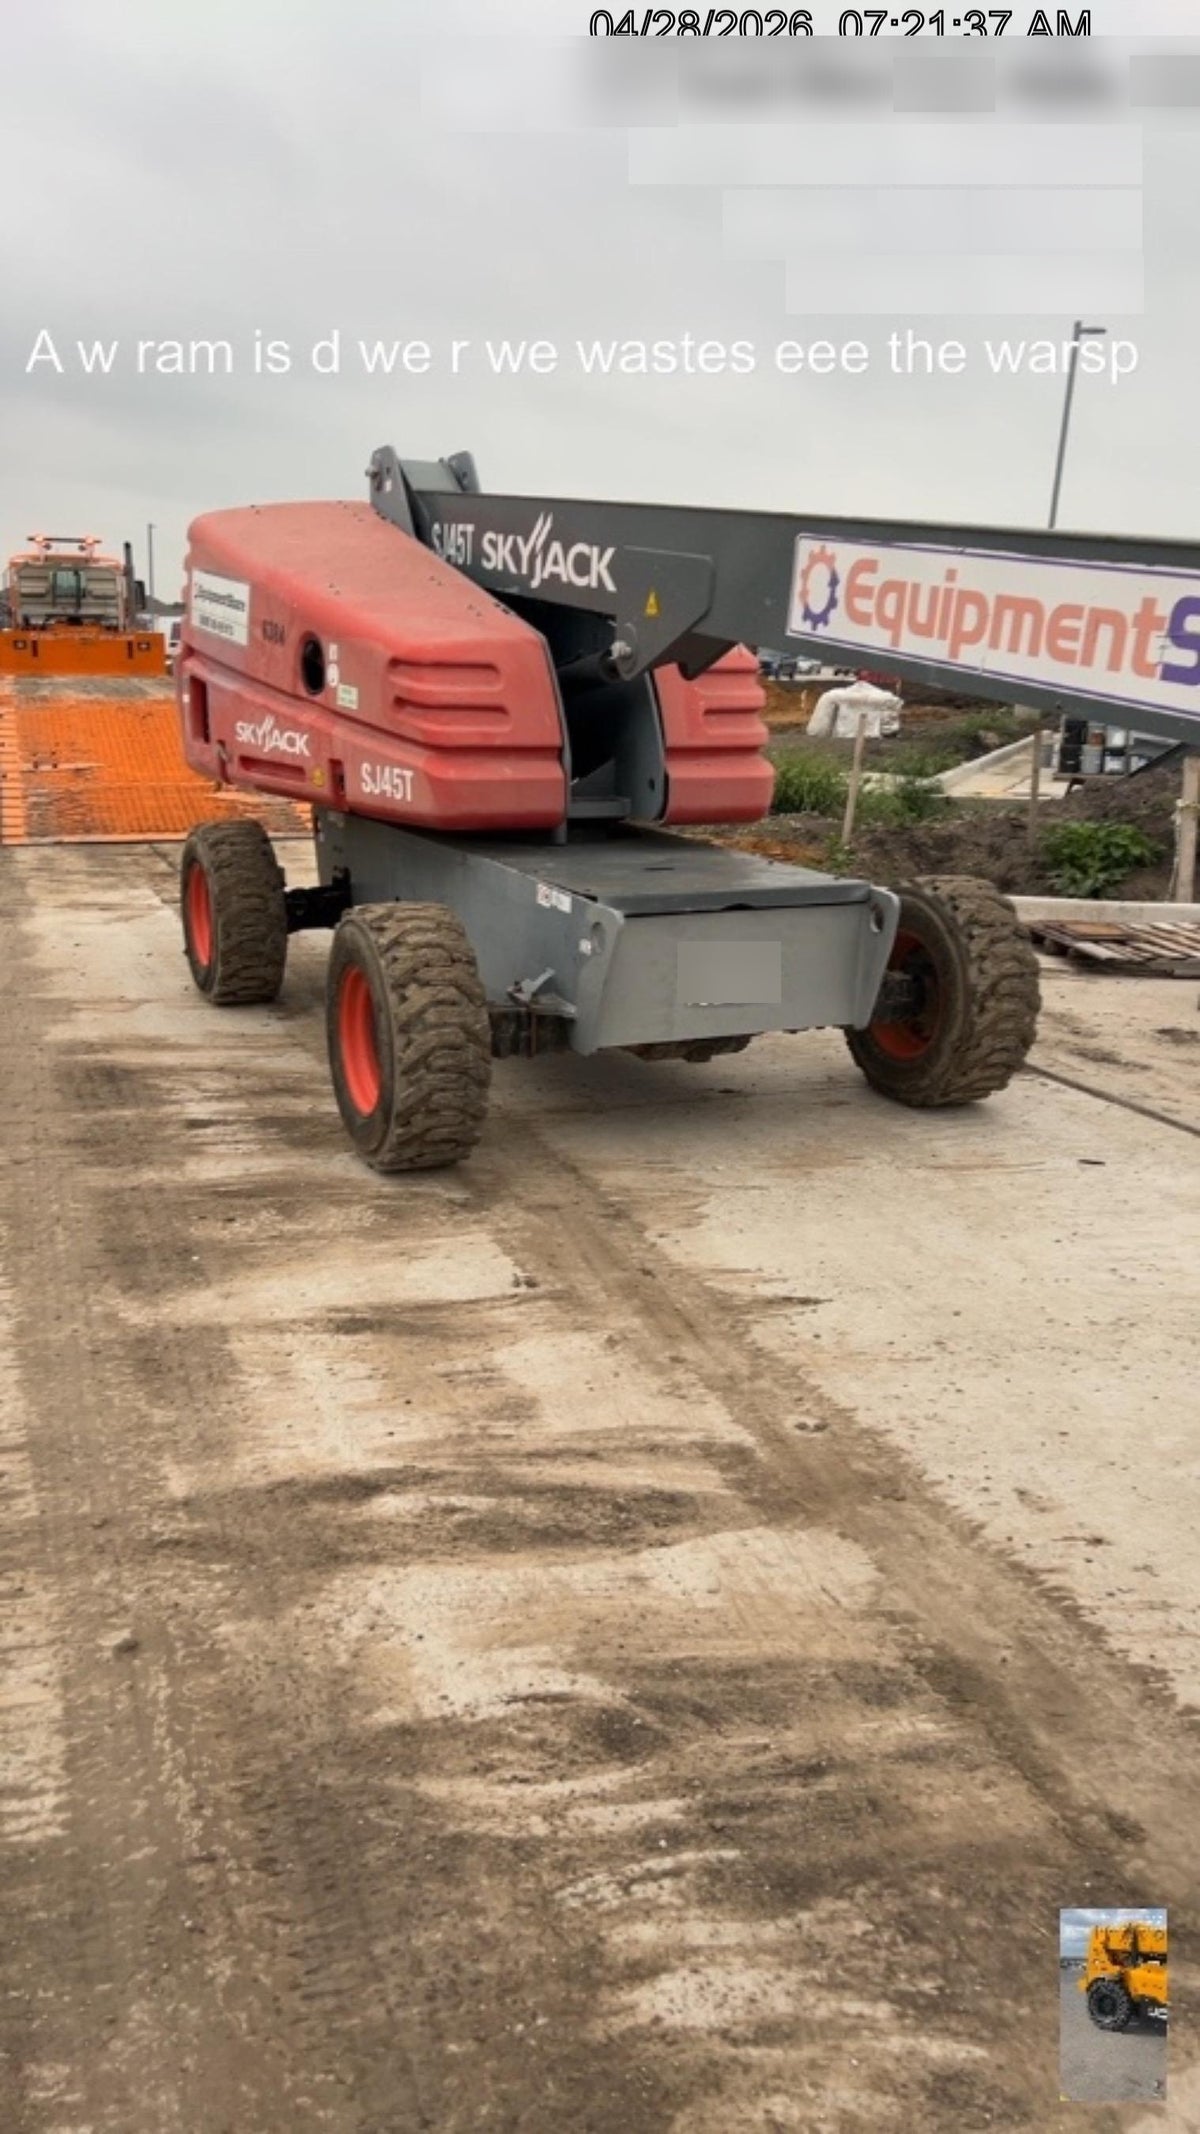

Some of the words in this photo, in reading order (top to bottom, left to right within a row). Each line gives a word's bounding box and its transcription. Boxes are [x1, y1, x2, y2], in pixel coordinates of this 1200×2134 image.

[431, 521, 475, 566] SJ45T
[481, 511, 617, 593] SKYJACK
[234, 715, 311, 757] SKYJACK
[360, 762, 414, 802] SJ45T
